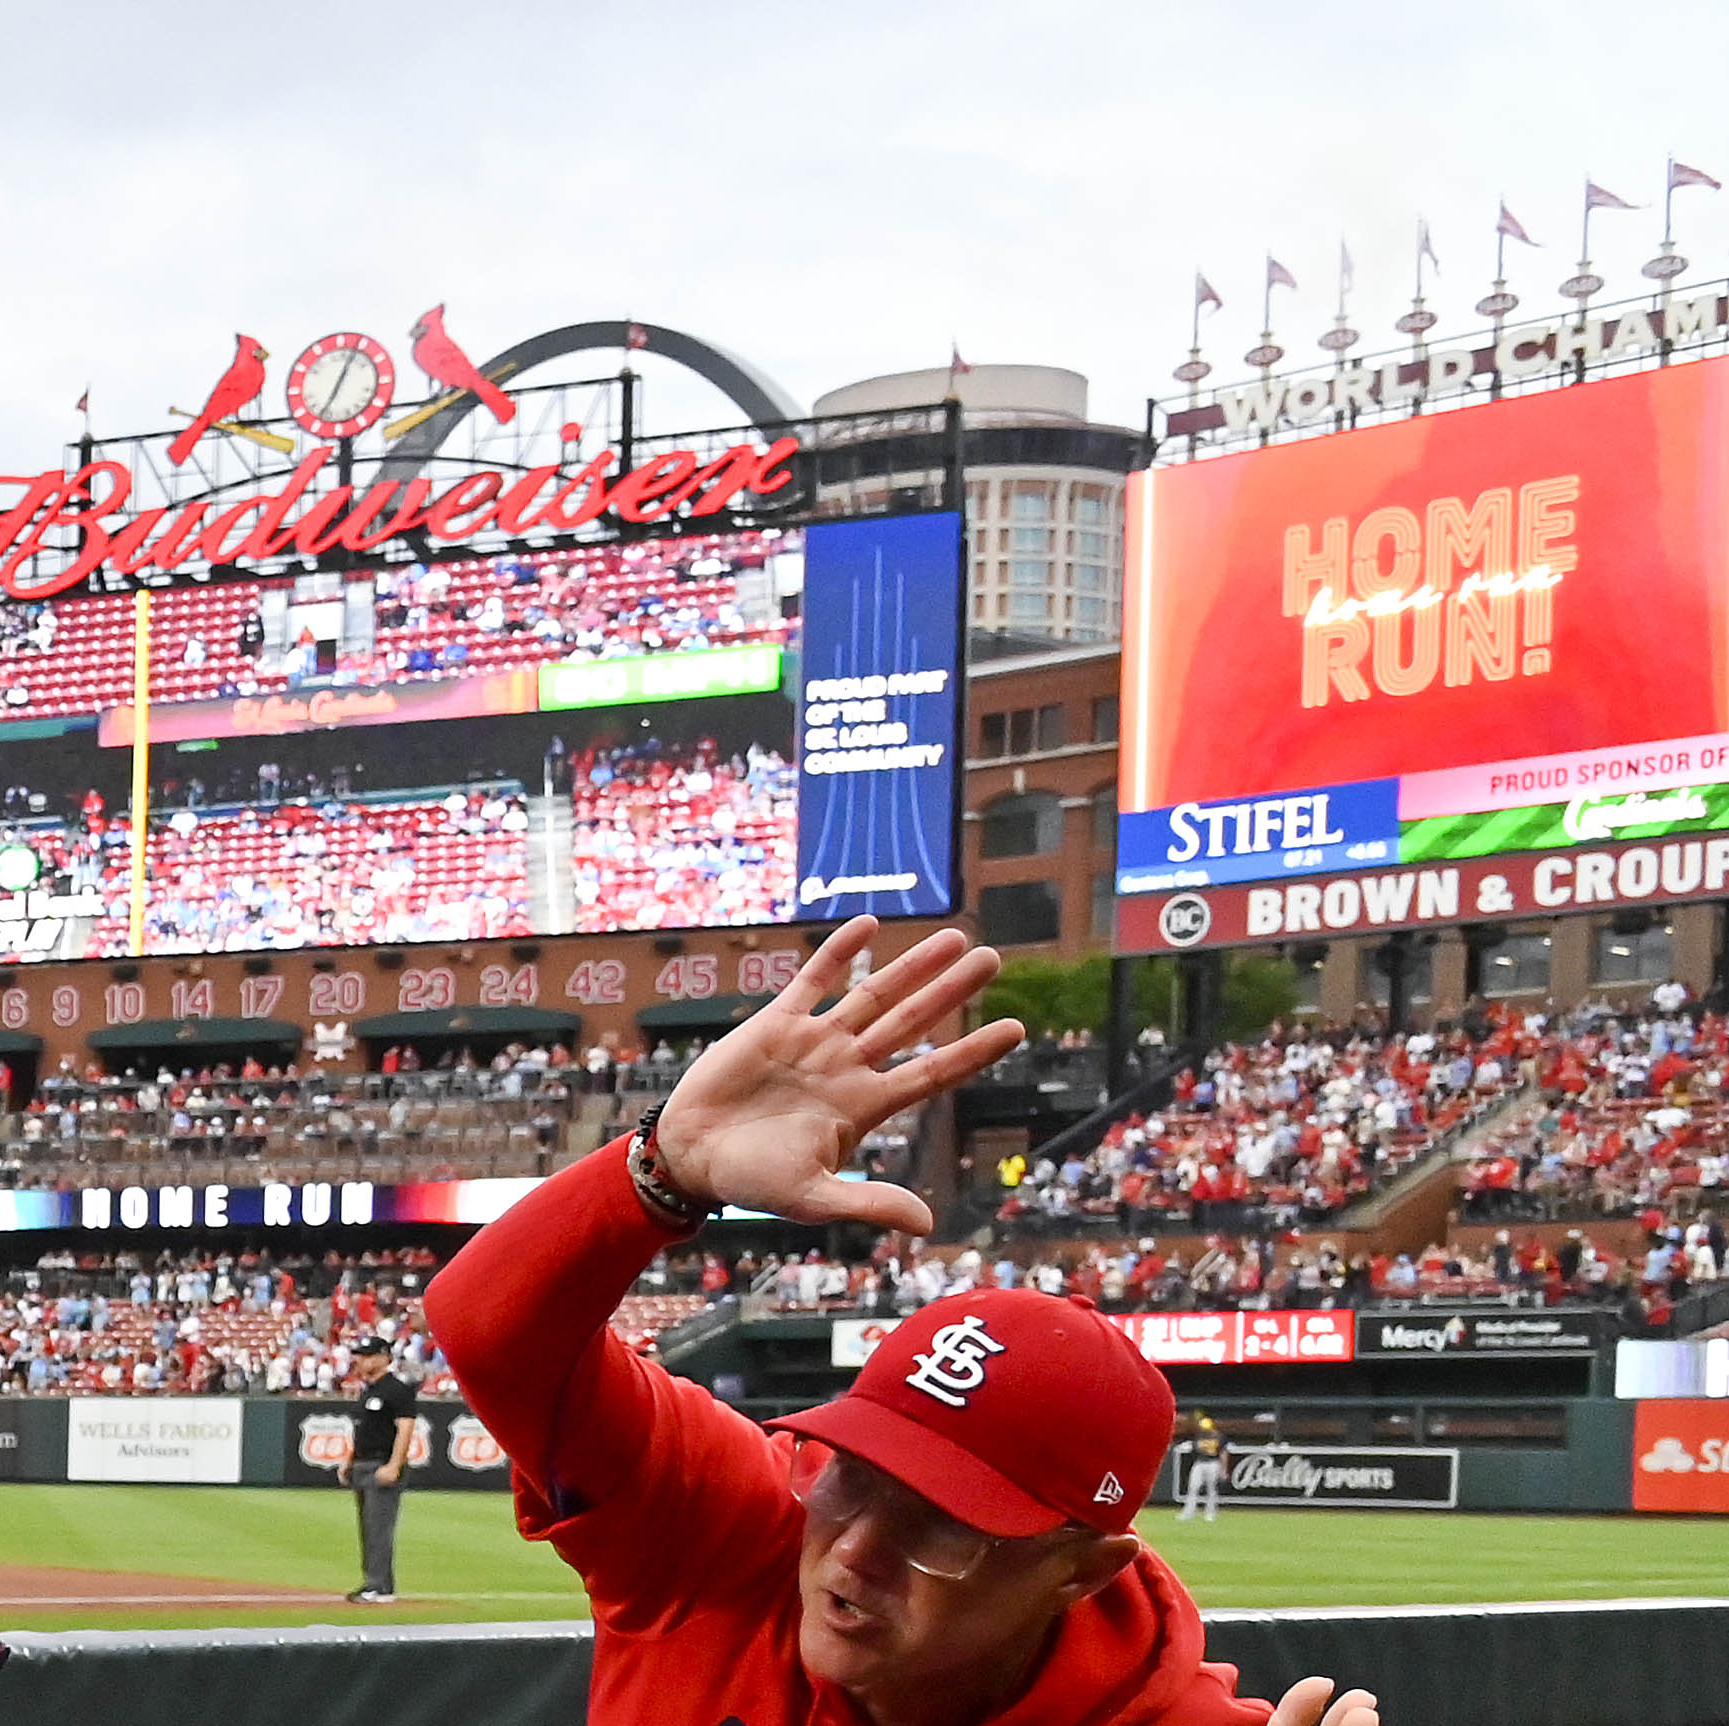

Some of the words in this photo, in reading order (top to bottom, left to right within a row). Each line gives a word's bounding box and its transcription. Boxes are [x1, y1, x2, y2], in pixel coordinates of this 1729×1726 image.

[1219, 349, 1474, 432] WORLD
[1282, 475, 1580, 617] HOME
[1301, 585, 1552, 709] RUN!
[1491, 768, 1568, 794] PROUD
[1577, 752, 1690, 785] SPONSOR
[1166, 794, 1344, 863] STIFEL
[1246, 868, 1459, 937] BROWN
[1477, 875, 1514, 914] &
[2, 988, 29, 1029] 6
[52, 985, 80, 1027] 9
[106, 982, 145, 1024] 10
[172, 979, 215, 1020] 14
[240, 975, 284, 1018] 17
[309, 971, 366, 1015] 20
[399, 968, 455, 1012] 23
[480, 963, 539, 1008] 24
[565, 959, 626, 1004] 42
[654, 954, 718, 999] 45
[737, 950, 799, 996] 85
[82, 1184, 229, 1229] HOME
[263, 1181, 374, 1226] RUN
[1381, 1324, 1447, 1352] Mercy
[79, 1422, 151, 1441] WELLS
[159, 1422, 232, 1441] FARGO
[1232, 1452, 1323, 1498] Bally
[1325, 1466, 1394, 1490] SPORTS
